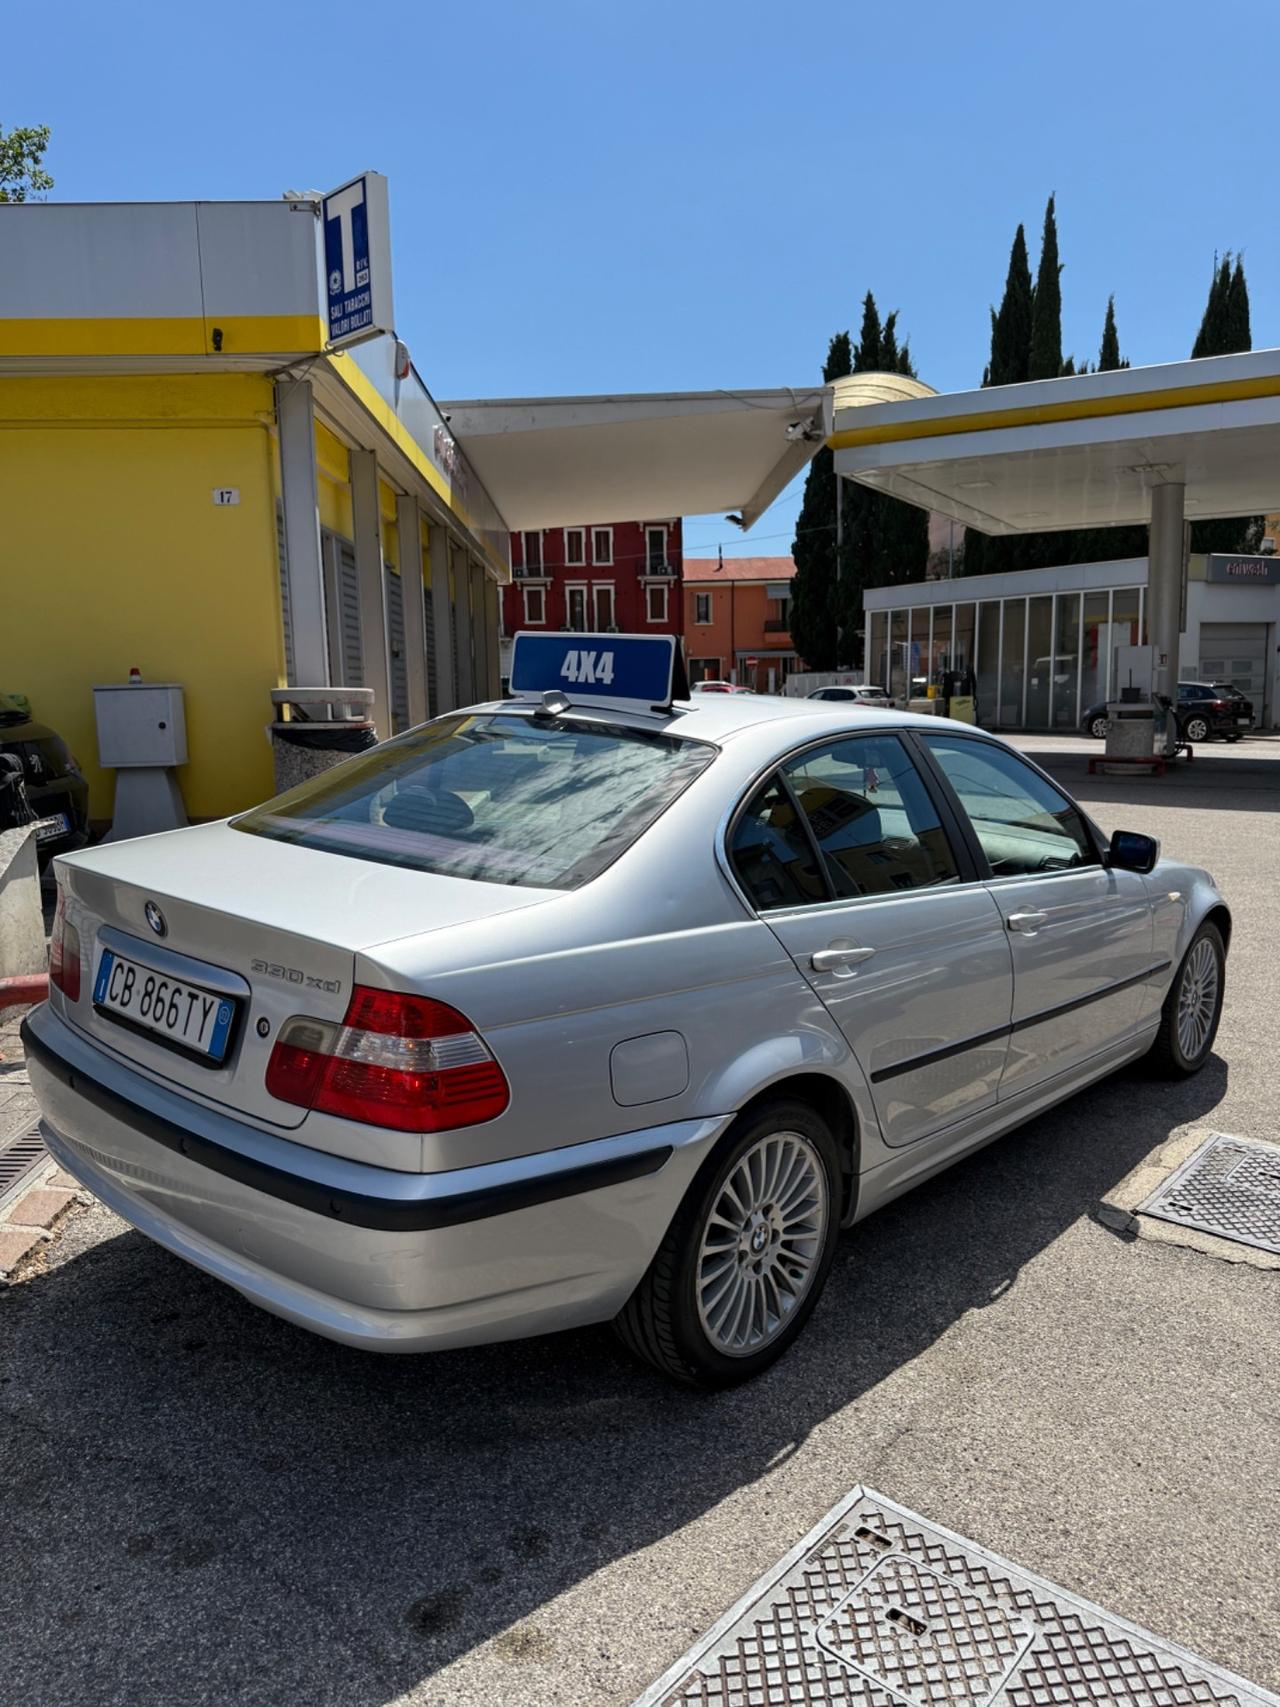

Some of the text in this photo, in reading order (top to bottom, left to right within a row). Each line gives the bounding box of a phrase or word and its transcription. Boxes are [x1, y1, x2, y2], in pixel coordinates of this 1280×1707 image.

[326, 180, 365, 294] T
[331, 291, 371, 320] SALI TABACCHI
[331, 309, 372, 337] VALORI BOLLATI
[220, 491, 233, 503] 17
[560, 650, 615, 685] 4X4
